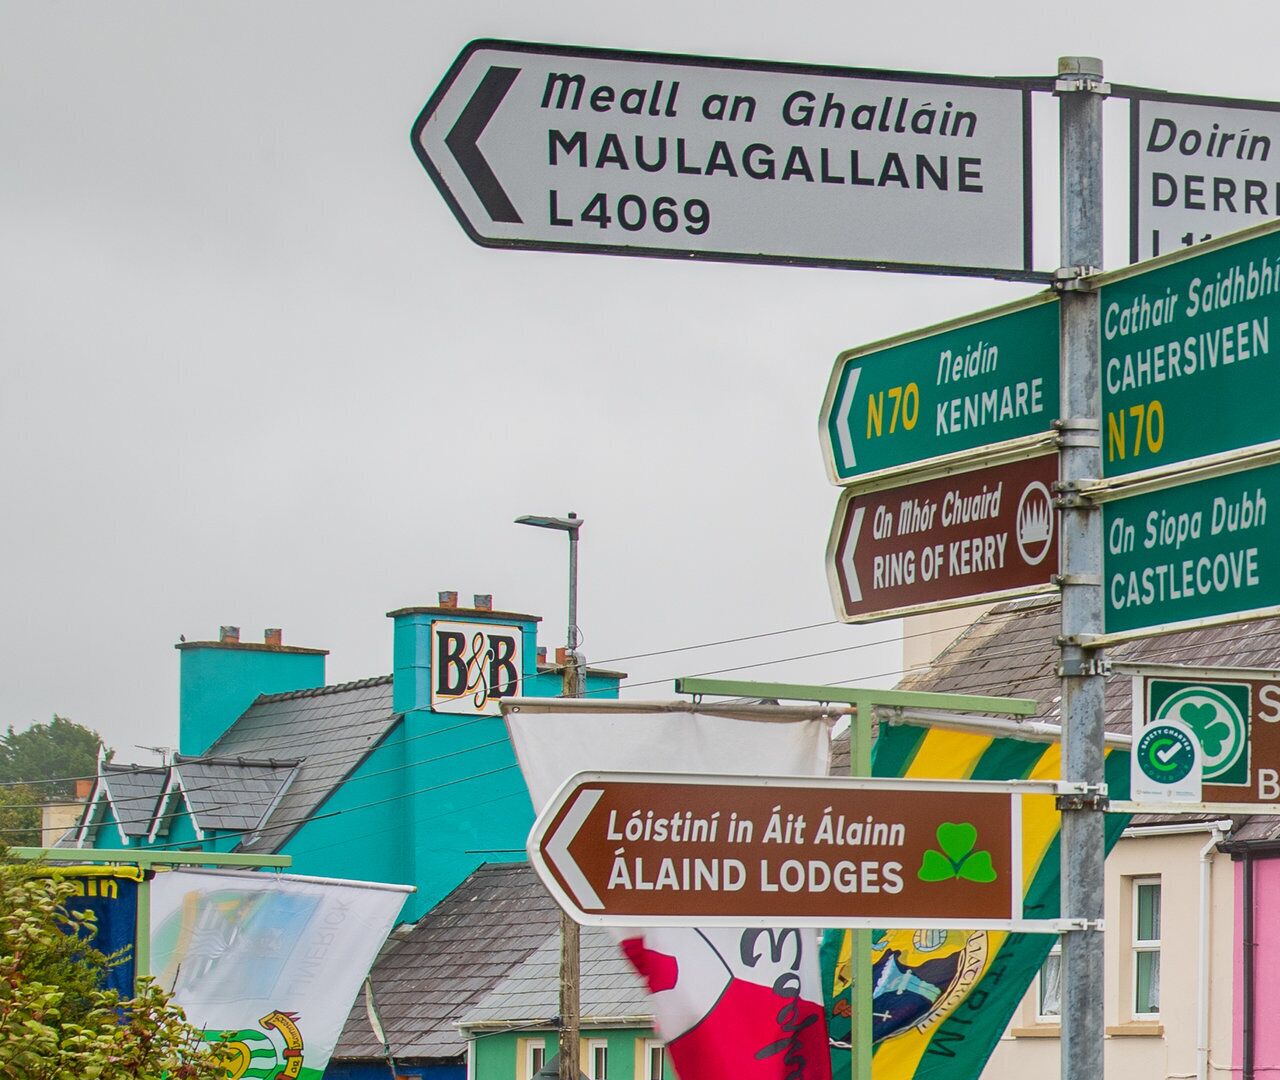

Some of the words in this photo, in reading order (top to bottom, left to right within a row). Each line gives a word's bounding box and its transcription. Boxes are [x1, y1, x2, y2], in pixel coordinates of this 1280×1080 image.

[541, 71, 680, 117] Meall
[702, 94, 757, 123] an
[783, 89, 978, 137] Ghalláin
[549, 129, 984, 193] MAULAGALLANE
[1146, 117, 1272, 162] Doirín
[550, 189, 711, 235] L4069
[1105, 290, 1177, 341] Cathair
[936, 344, 998, 385] Neidín
[1107, 318, 1269, 394] CAHERSIVEEN
[866, 383, 919, 438] N70
[936, 377, 1043, 435] KENMARE
[1108, 401, 1164, 462] N70
[874, 511, 895, 540] An
[899, 500, 936, 537] Mhór
[942, 481, 1002, 528] Chuaird
[1110, 517, 1134, 554] An
[1145, 506, 1202, 549] Siopa
[1213, 490, 1267, 535] Dubh
[874, 552, 915, 589] RING
[921, 551, 943, 580] OF
[949, 532, 1007, 574] KERRY
[1111, 547, 1259, 610] CASTLECOVE
[435, 630, 518, 709] B&B
[607, 809, 719, 843] Lóistiní
[727, 812, 753, 844] in
[762, 805, 806, 845] Áit
[814, 806, 906, 847] Álainn
[607, 848, 746, 892] ÁLAIND
[761, 859, 904, 894] LODGES
